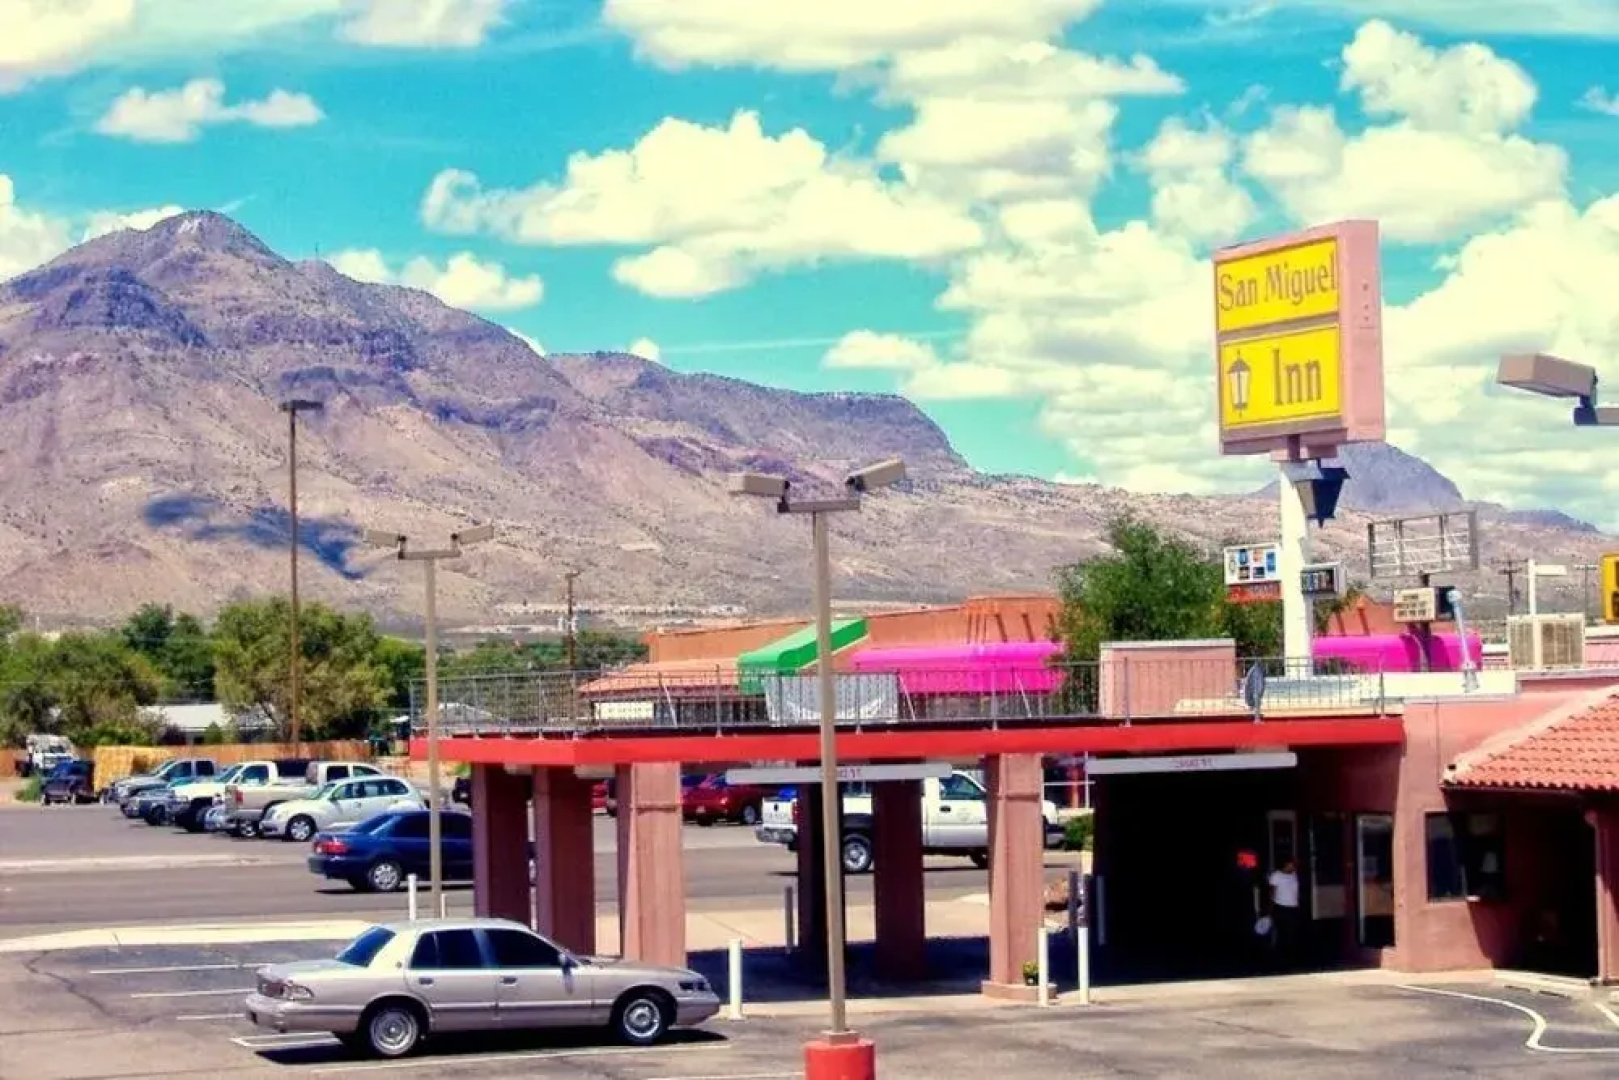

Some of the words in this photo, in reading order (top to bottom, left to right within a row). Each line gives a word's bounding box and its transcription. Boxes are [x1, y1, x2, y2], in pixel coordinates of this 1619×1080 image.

[1219, 274, 1259, 311] San
[1265, 252, 1336, 305] Miguel
[1273, 349, 1322, 406] Inn
